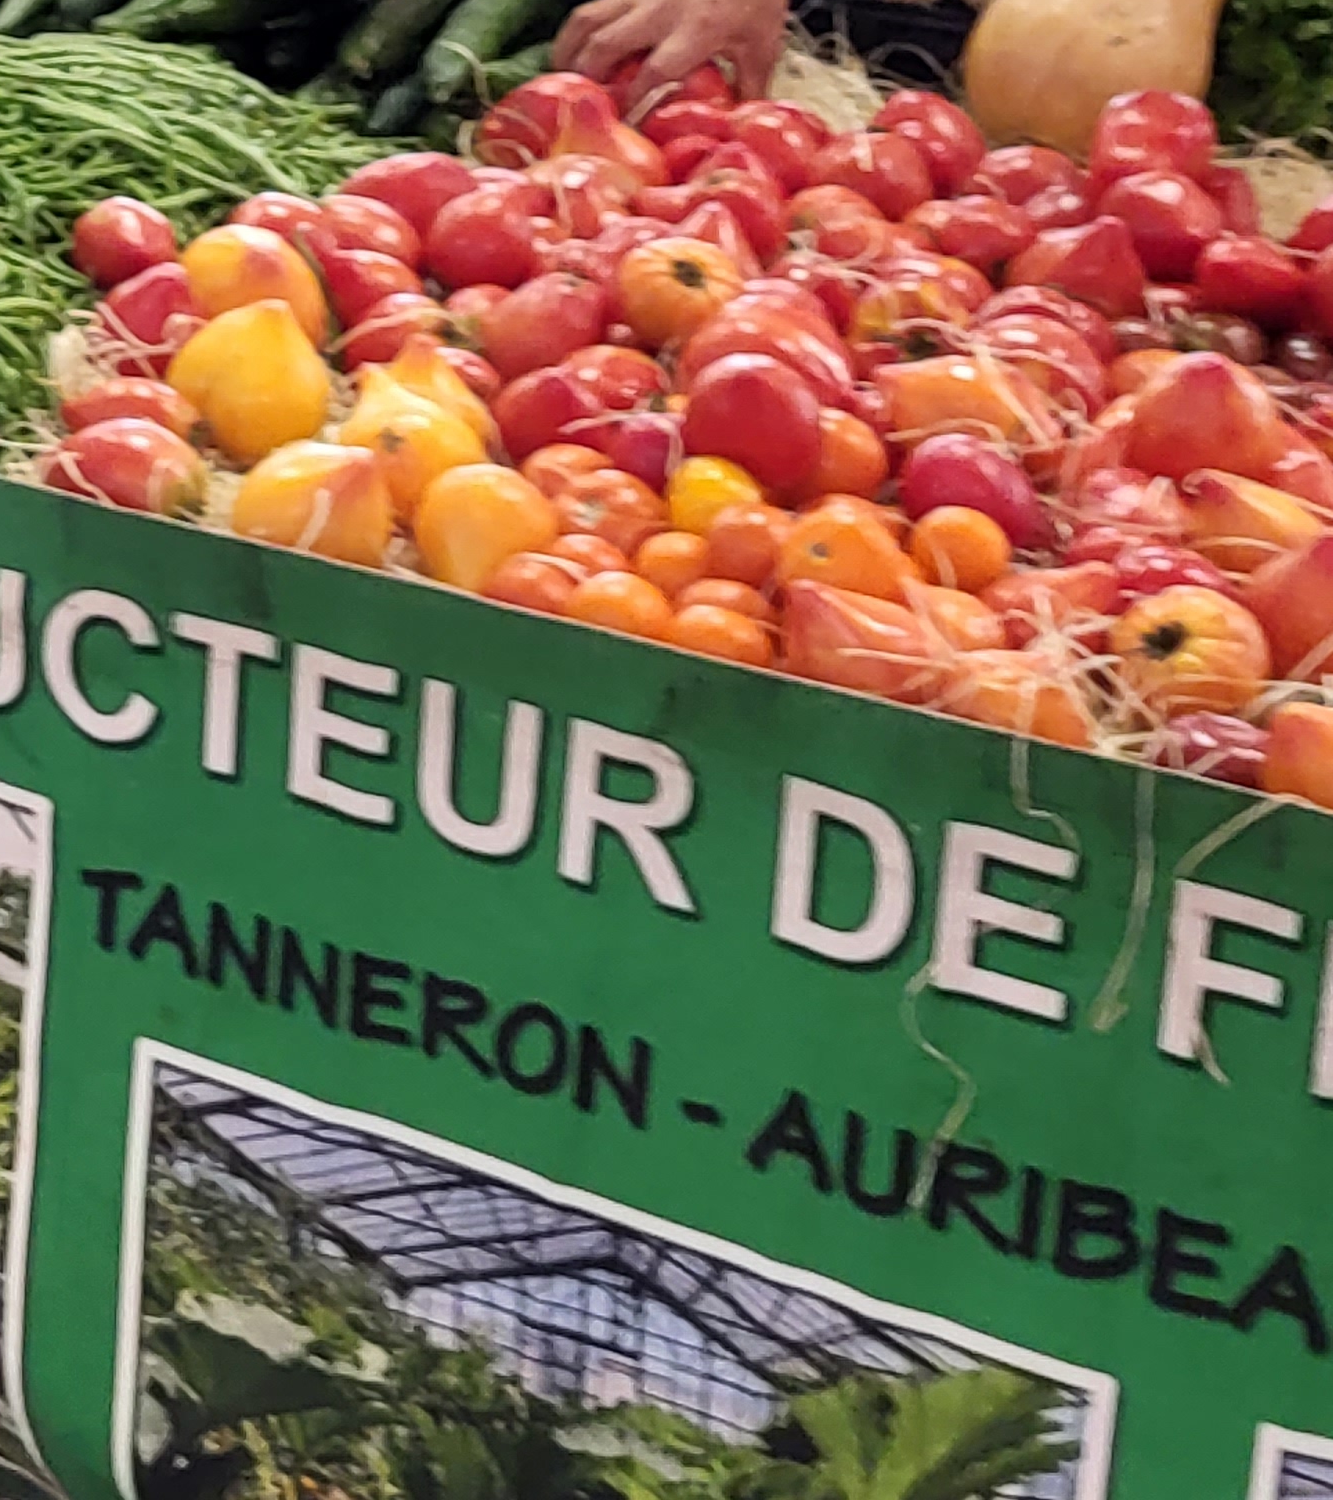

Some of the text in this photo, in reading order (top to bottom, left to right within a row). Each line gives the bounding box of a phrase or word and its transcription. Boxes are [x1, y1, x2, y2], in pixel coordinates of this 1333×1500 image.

[81, 868, 654, 1130] TANNERON
[744, 1088, 1333, 1357] AURIBEA
[771, 773, 1081, 1023] DE
[1157, 877, 1333, 1101] F
